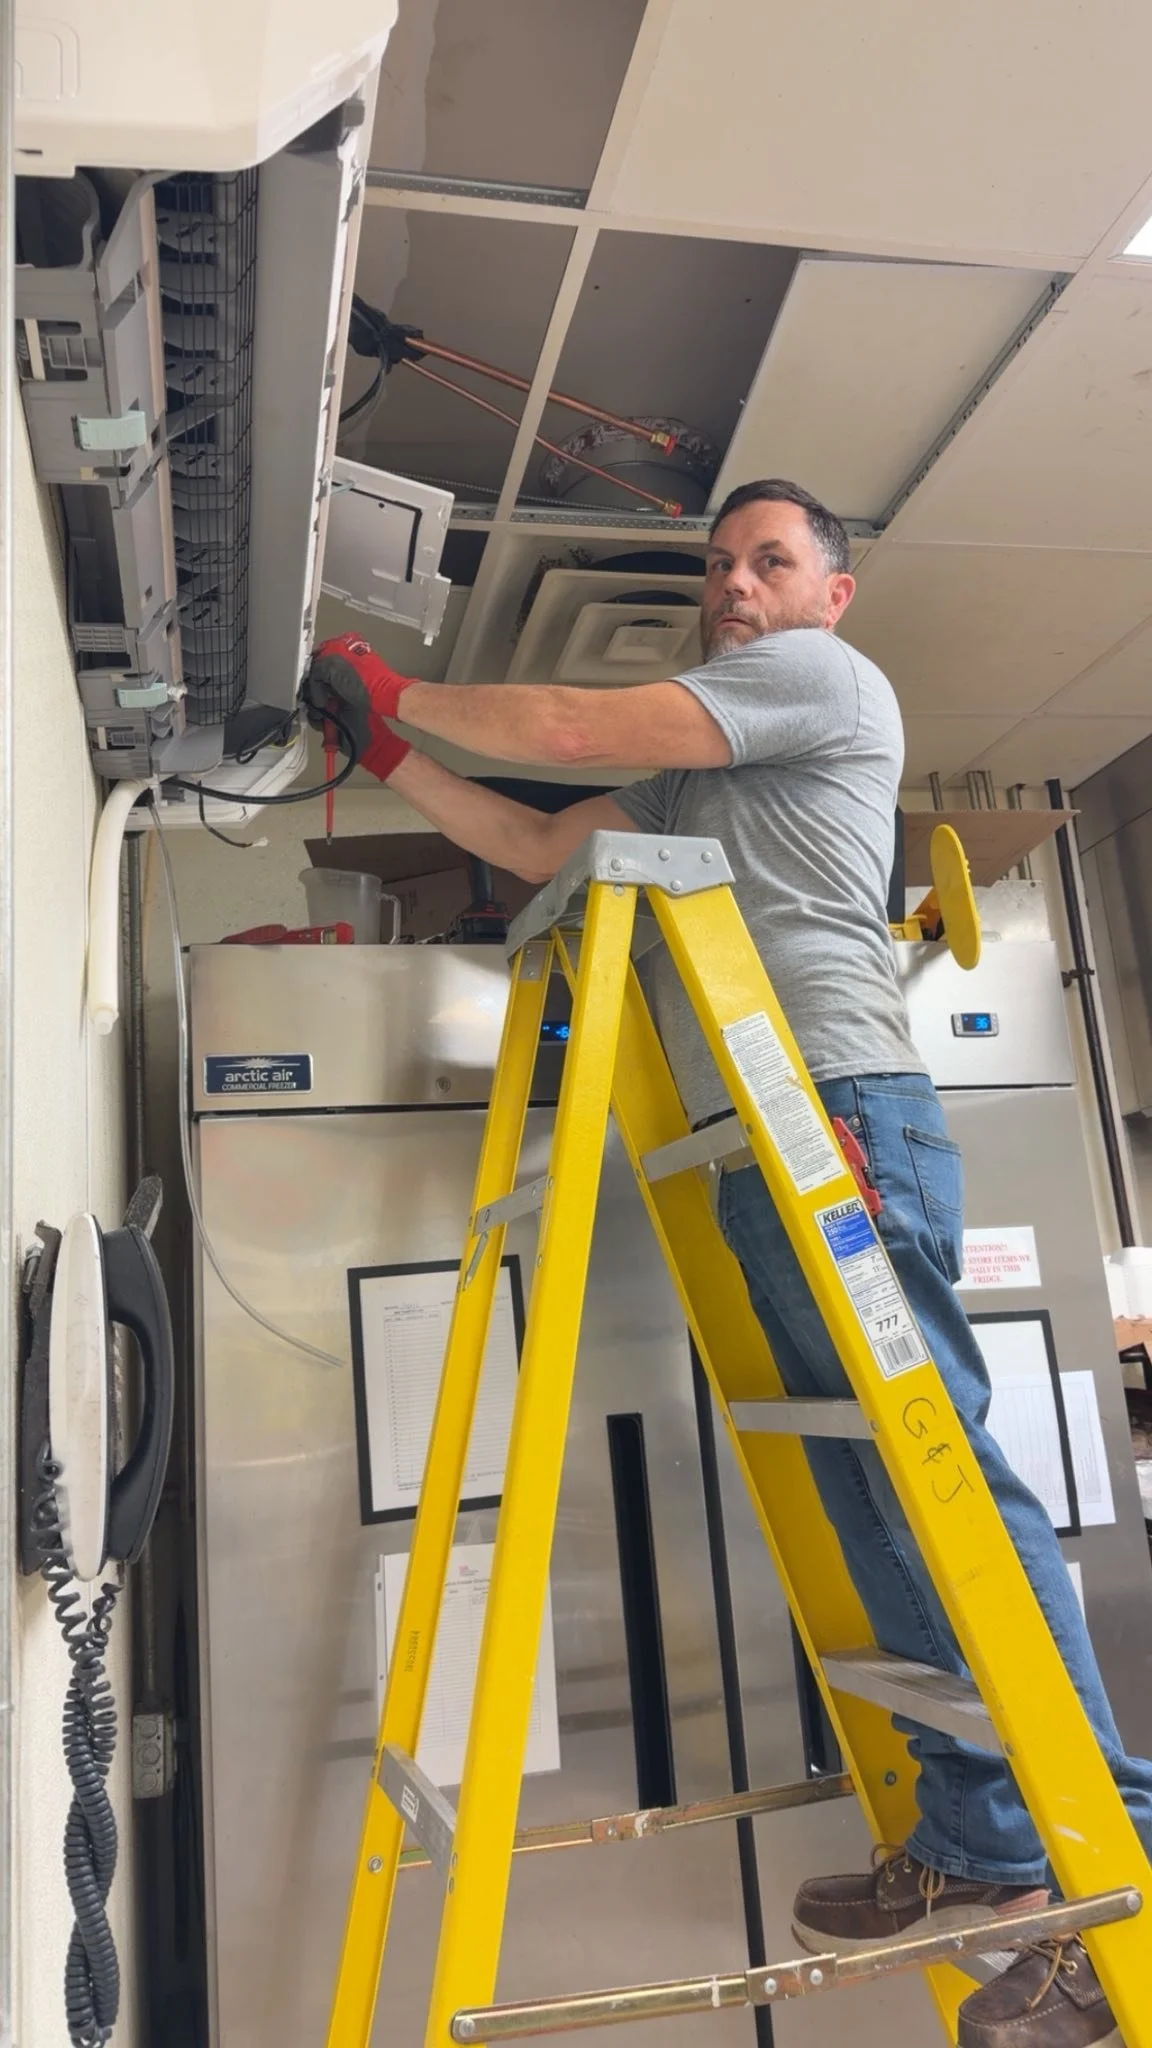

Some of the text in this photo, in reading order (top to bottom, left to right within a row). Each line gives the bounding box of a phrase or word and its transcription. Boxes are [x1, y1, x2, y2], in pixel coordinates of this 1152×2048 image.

[976, 1016, 989, 1030] 36
[225, 1069, 293, 1082] arctic air
[222, 1083, 267, 1091] COMMERCIAL
[823, 1203, 860, 1224] KELLER
[968, 1255, 992, 1265] STORE
[994, 1255, 1017, 1264] ITEMS
[968, 1266, 992, 1274] DAILY
[1002, 1264, 1021, 1273] THIS
[875, 1314, 898, 1333] 777
